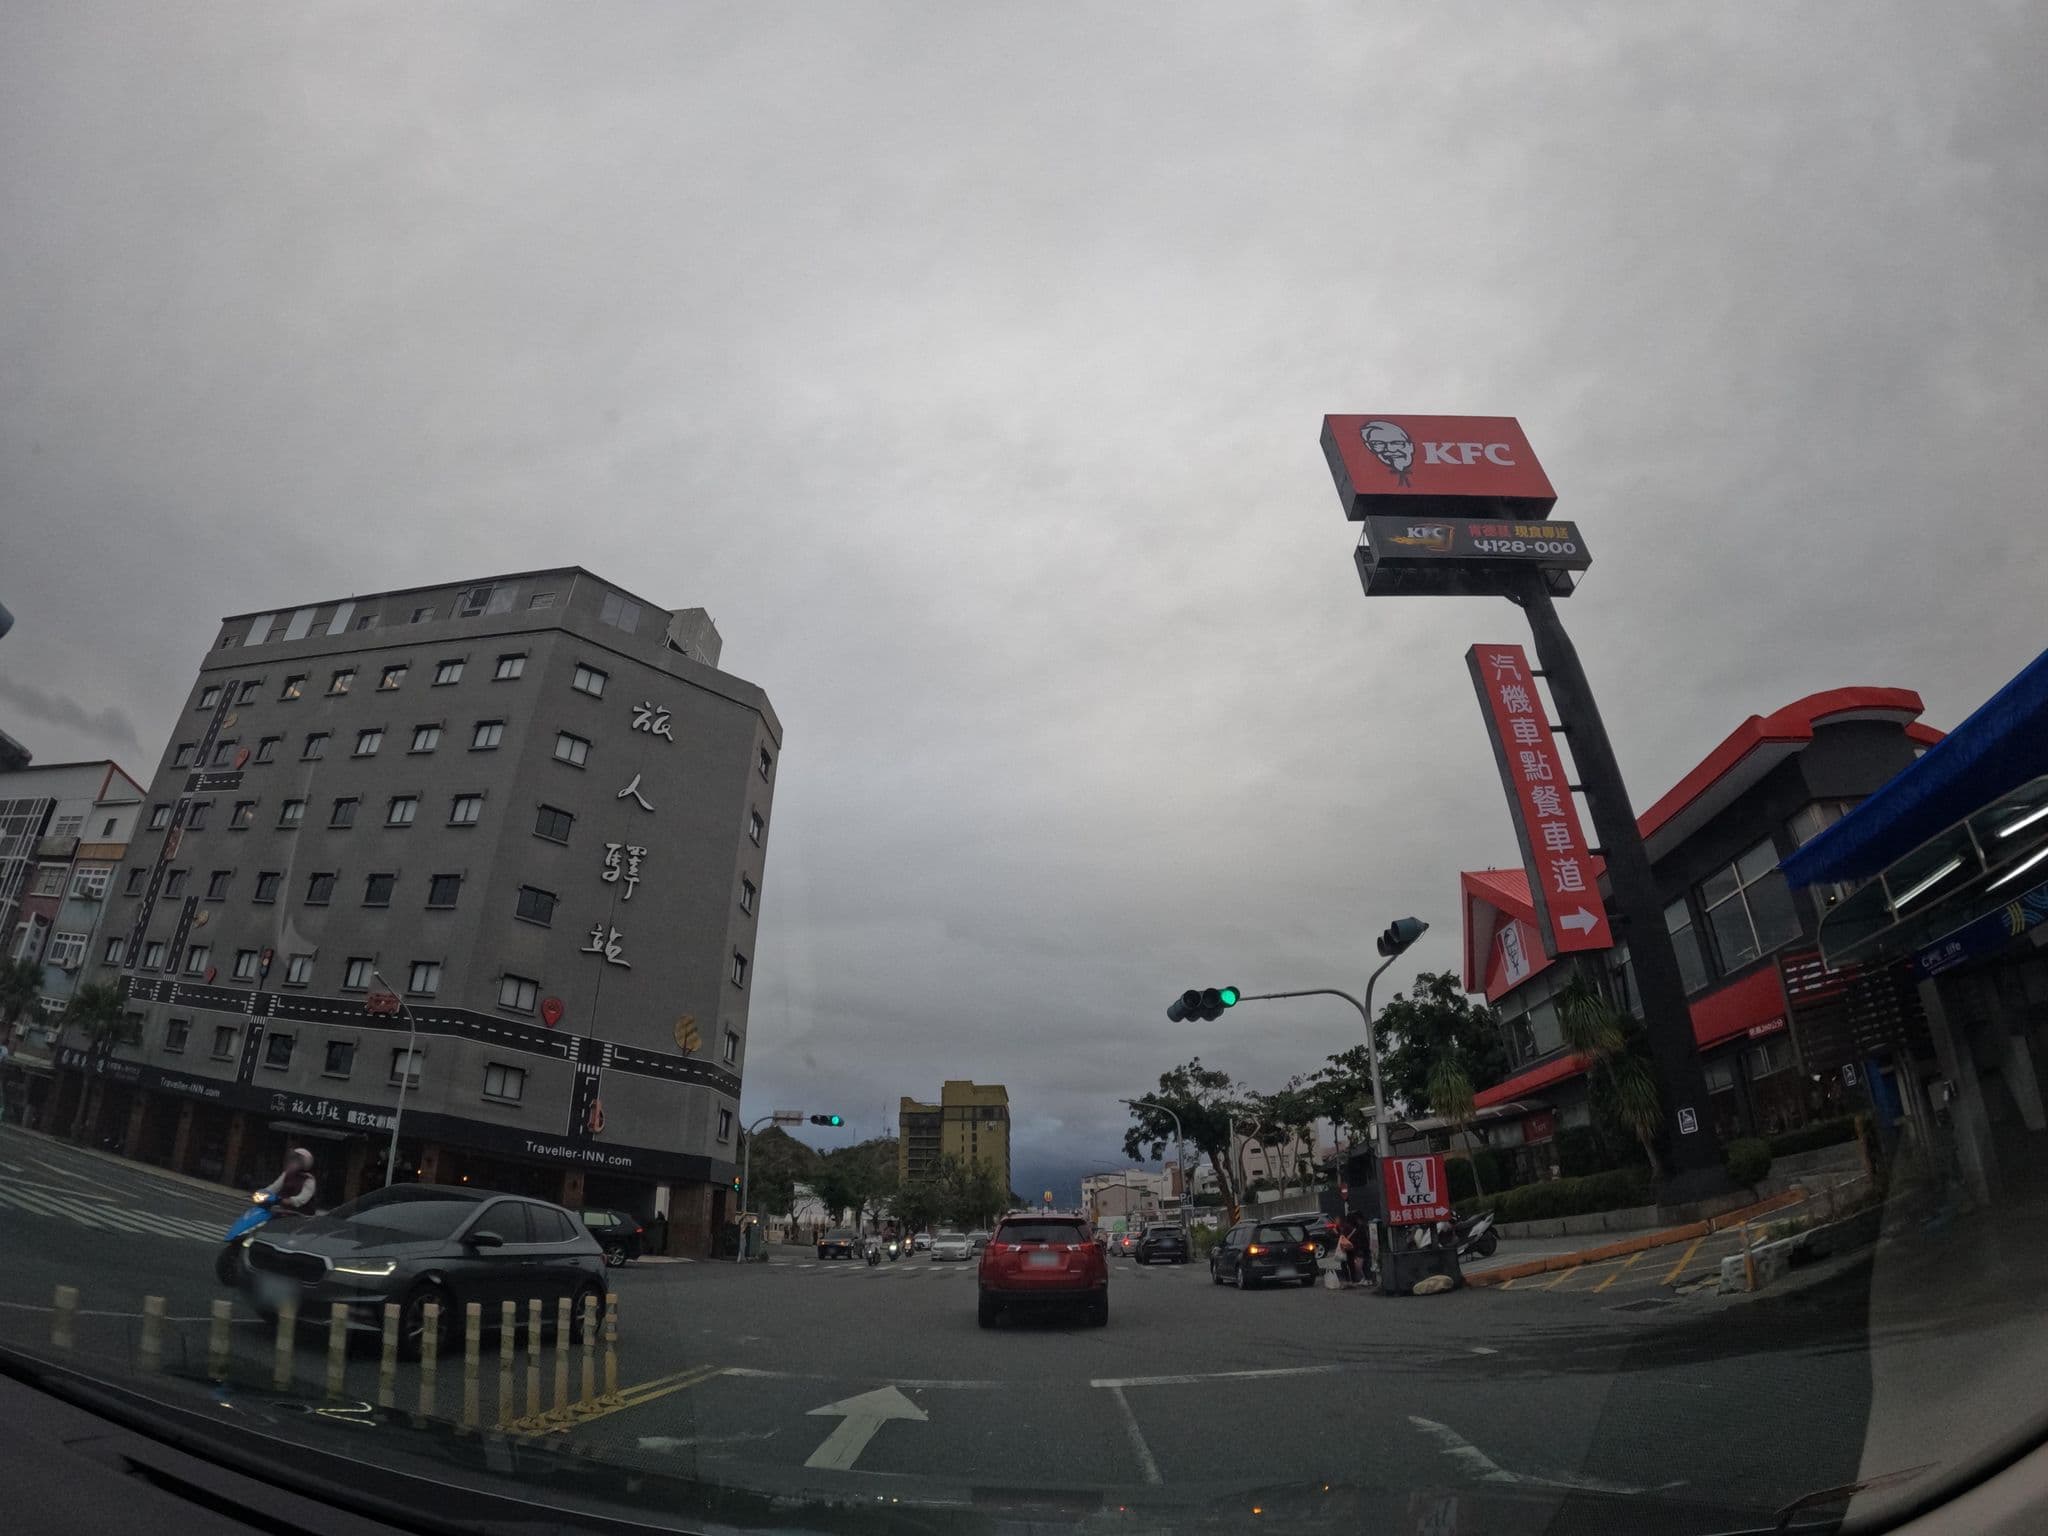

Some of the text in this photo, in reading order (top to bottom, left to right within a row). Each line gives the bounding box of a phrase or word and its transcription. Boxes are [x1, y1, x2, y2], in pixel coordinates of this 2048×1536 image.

[1422, 442, 1516, 466] KFC
[1407, 527, 1442, 538] KFC
[1473, 539, 1577, 555] 4128-000
[1489, 653, 1587, 894] 汽機車點餐車道
[525, 1140, 633, 1167] Traveller-INN.com
[1406, 1193, 1432, 1204] KFC
